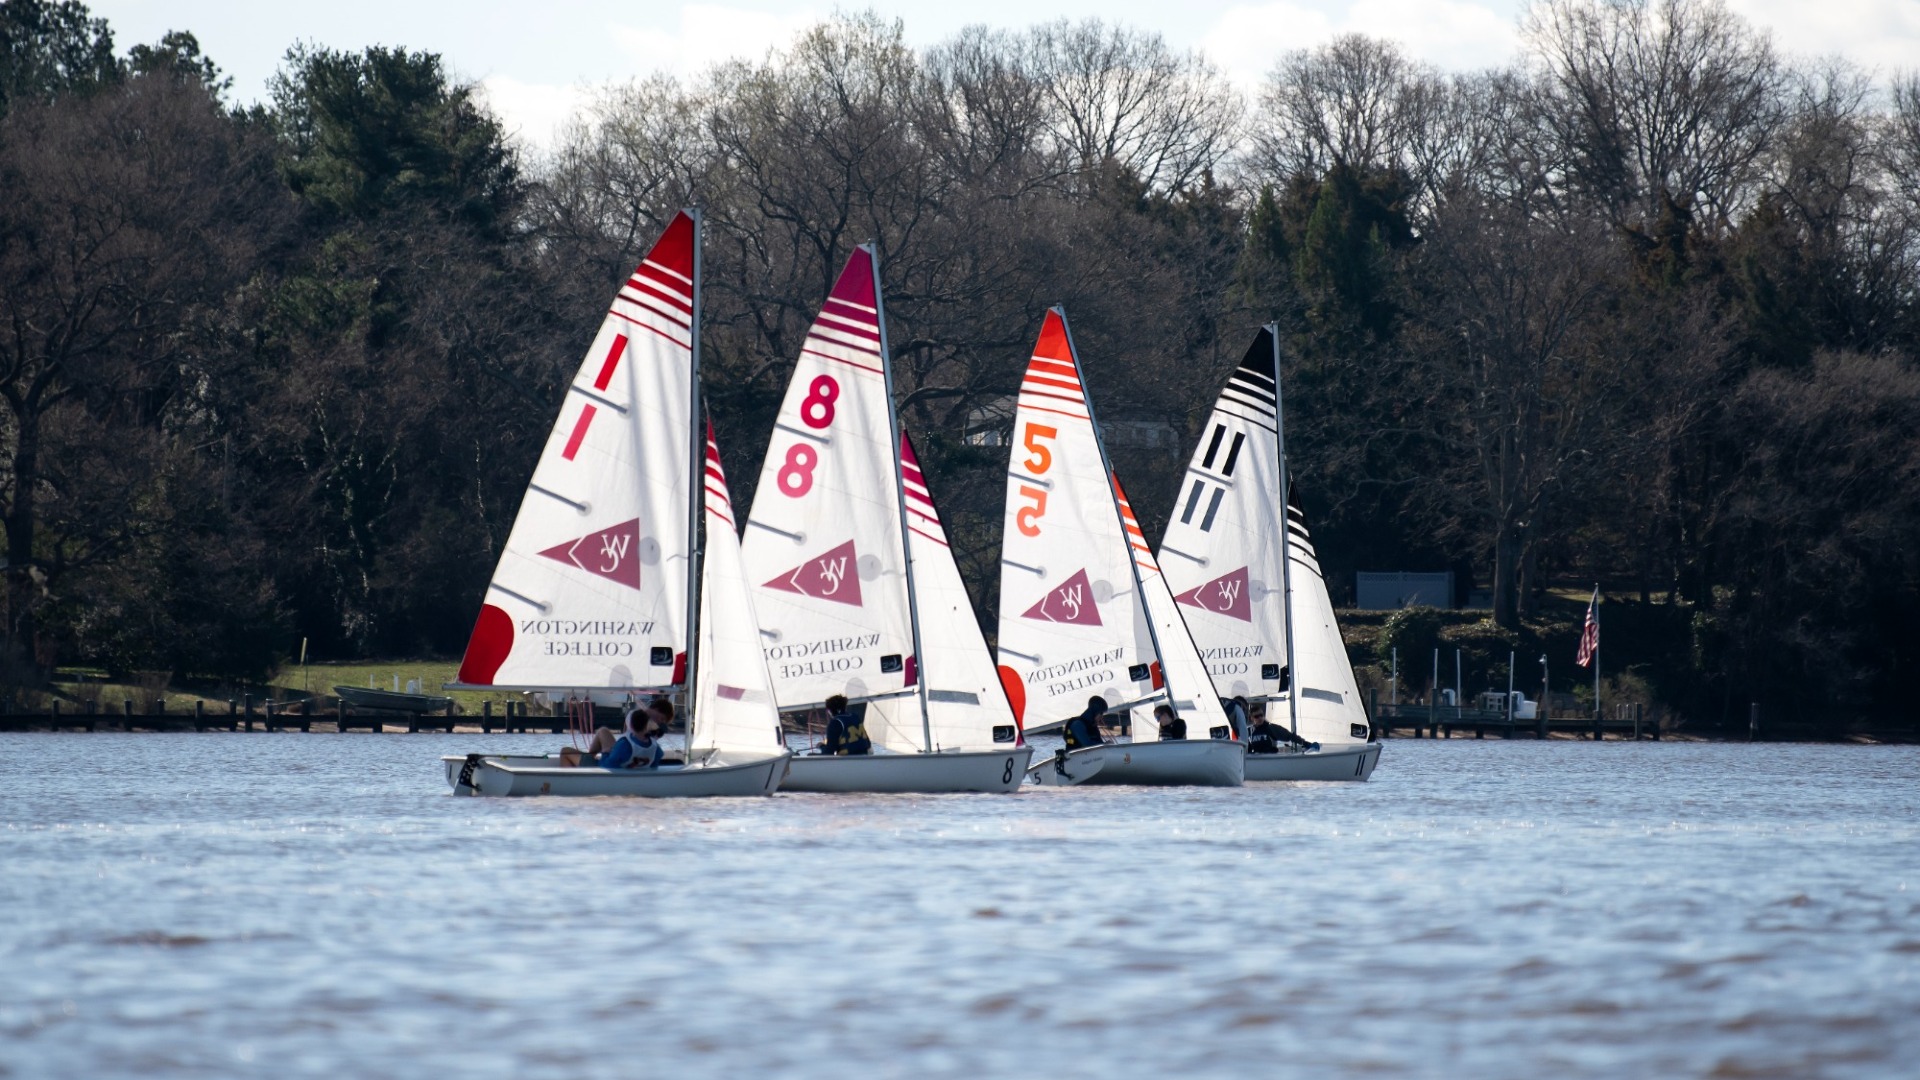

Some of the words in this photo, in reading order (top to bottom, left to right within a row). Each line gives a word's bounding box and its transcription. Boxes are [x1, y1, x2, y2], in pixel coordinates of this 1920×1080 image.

[800, 374, 840, 429] 8
[1023, 421, 1058, 475] 5
[1202, 423, 1246, 477] 11
[1002, 757, 1015, 784] 8
[1034, 771, 1042, 786] 5
[1354, 753, 1367, 776] 11
